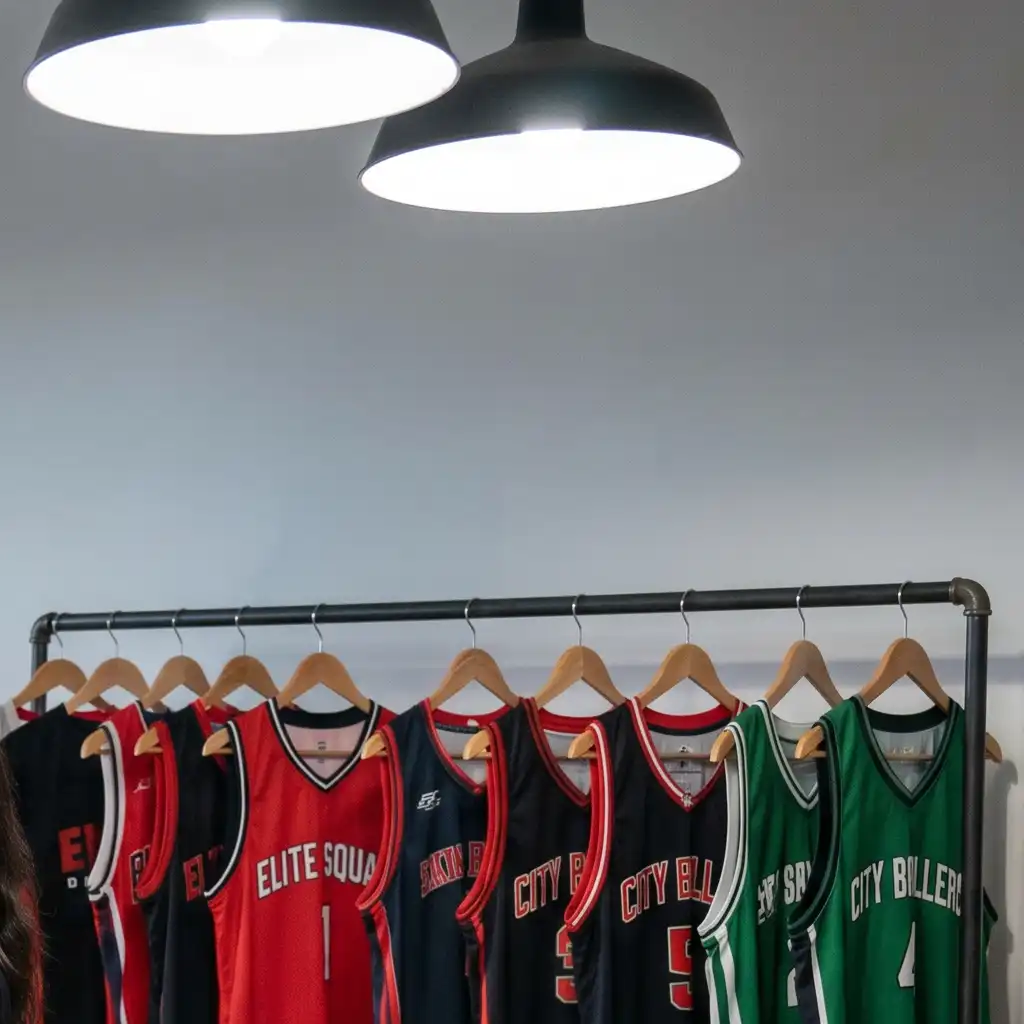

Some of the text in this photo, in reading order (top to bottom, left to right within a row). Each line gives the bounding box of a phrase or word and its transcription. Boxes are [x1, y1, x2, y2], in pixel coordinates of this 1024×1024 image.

[256, 842, 319, 899] ELITE
[514, 856, 562, 919] CITY
[620, 860, 668, 923] CITY
[851, 860, 885, 922] CITY
